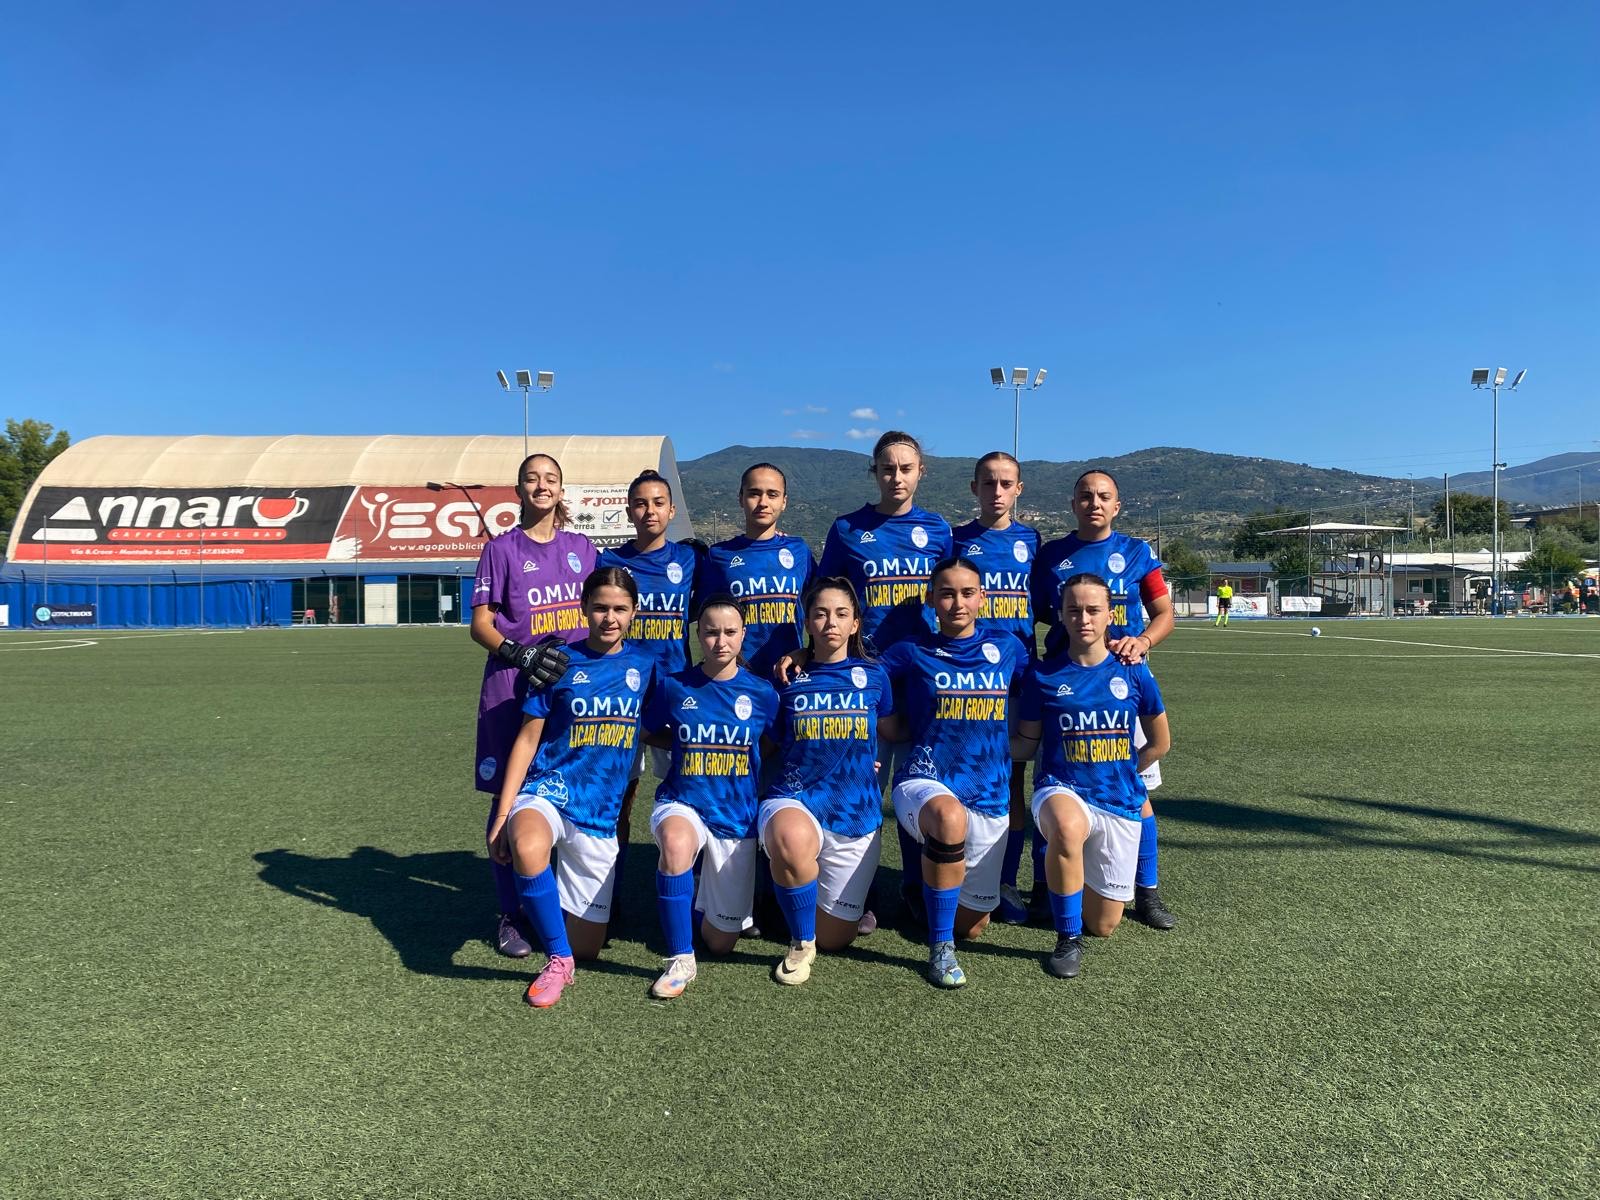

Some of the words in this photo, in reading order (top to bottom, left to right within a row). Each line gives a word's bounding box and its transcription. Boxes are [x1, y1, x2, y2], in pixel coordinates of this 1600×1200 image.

[592, 496, 629, 507] Jom
[388, 501, 521, 539] EGO
[389, 542, 485, 552] www.egopubblicit
[865, 584, 891, 607] LICARI
[993, 596, 1018, 618] GROUP
[531, 612, 556, 636] LICARI
[557, 608, 580, 632] GROUP
[743, 604, 759, 625] ARI
[759, 602, 786, 624] GROUP
[644, 619, 672, 640] GROUP
[936, 698, 964, 720] LICARI
[966, 698, 994, 721] GROUP
[569, 724, 598, 749] LICARI
[598, 723, 625, 748] GROUP
[794, 716, 820, 741] LICARI
[822, 715, 852, 740] GROUP
[854, 715, 868, 740] SRL
[1062, 740, 1089, 762] LICARI
[1116, 738, 1131, 761] SRL
[705, 752, 734, 776] GROUP
[735, 752, 749, 776] SRL
